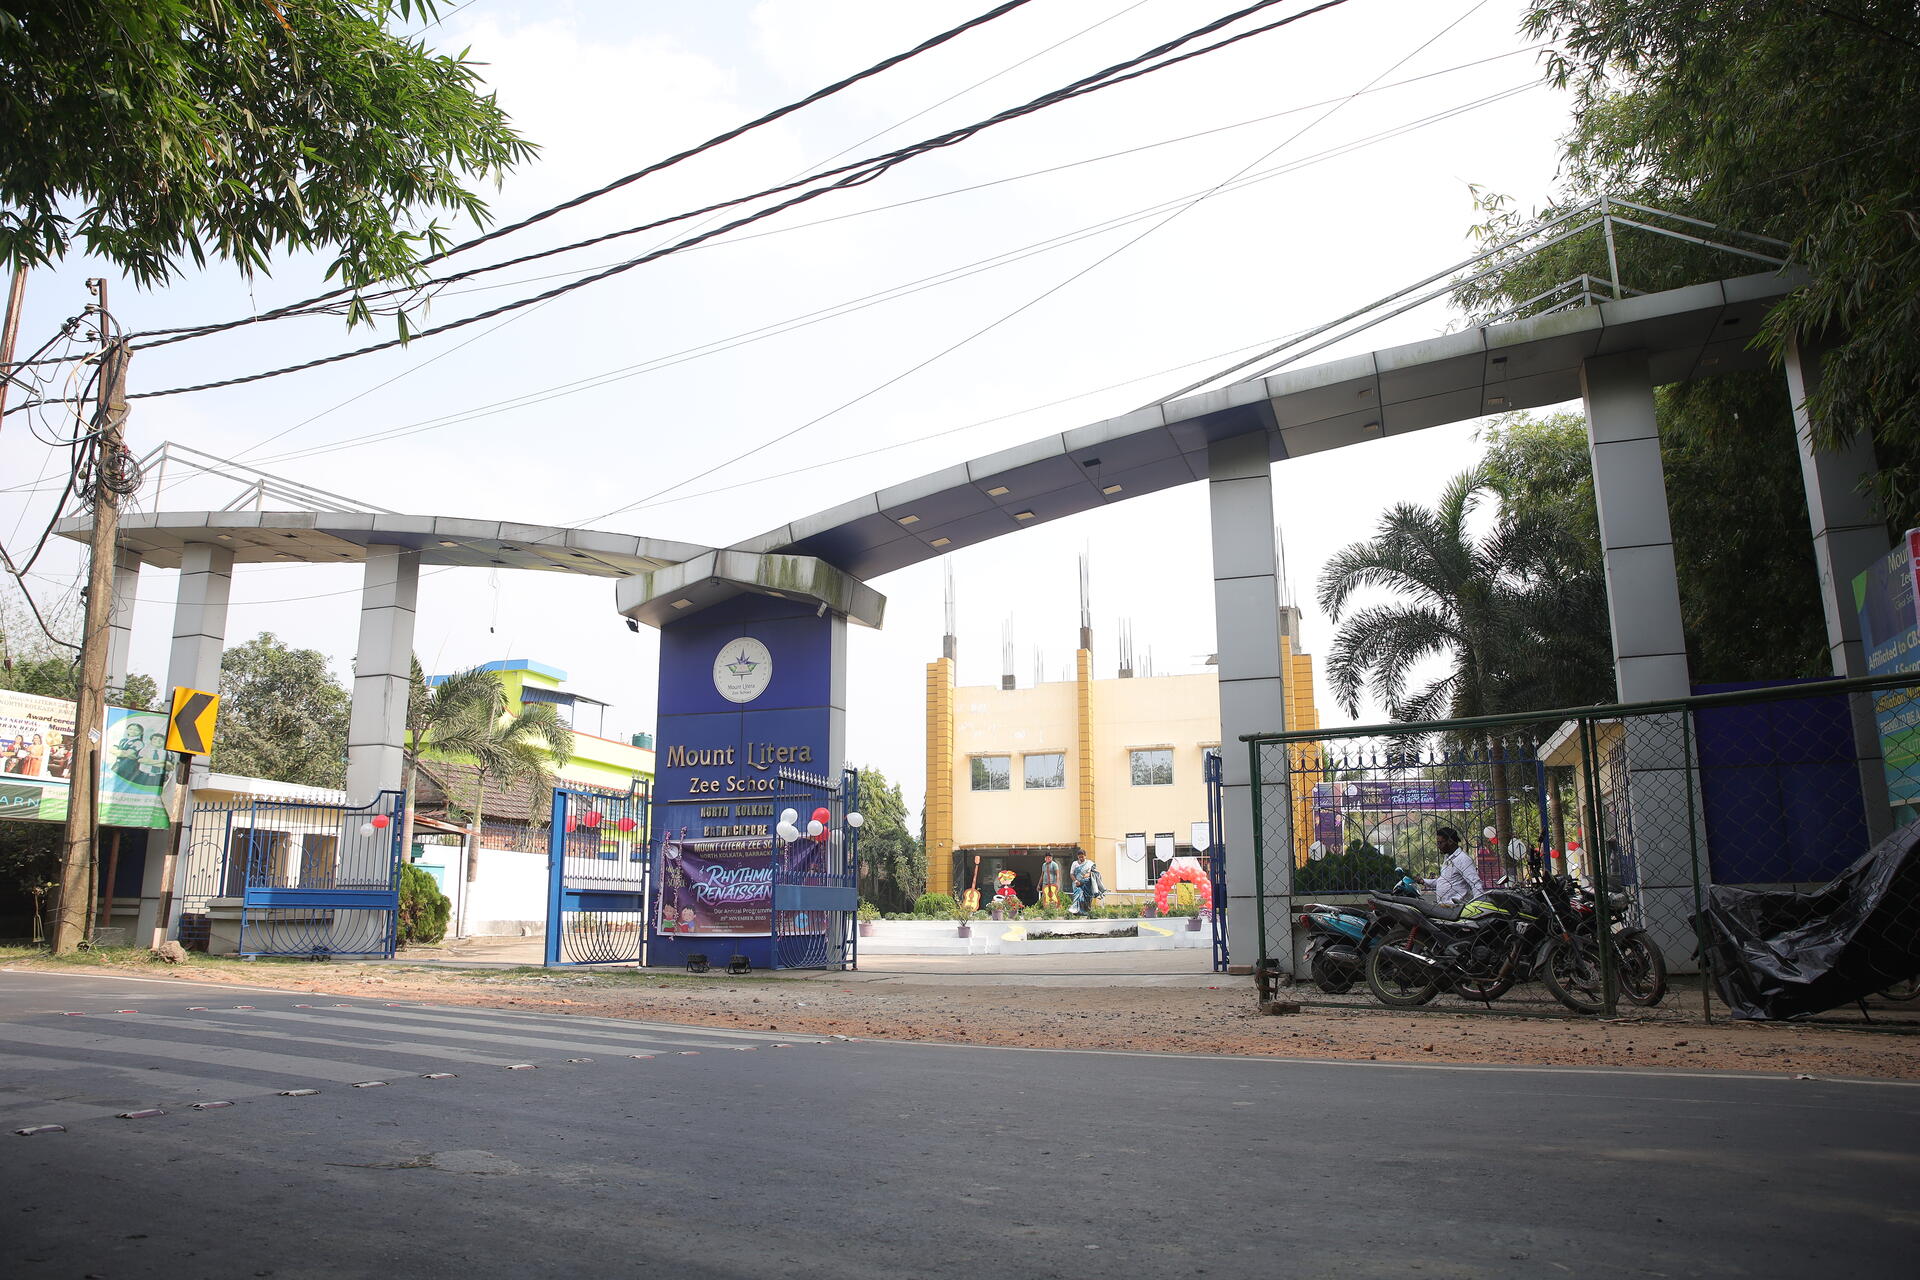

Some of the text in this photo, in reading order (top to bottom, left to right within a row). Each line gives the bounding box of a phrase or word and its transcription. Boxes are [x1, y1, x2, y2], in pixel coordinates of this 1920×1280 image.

[26, 713, 53, 722] Award
[666, 742, 813, 771] Mount Litera
[689, 777, 720, 793] Zee
[700, 804, 774, 817] NORTH KOLKATA
[703, 824, 768, 837] BARRACKPORE
[694, 842, 719, 853] MOUNT
[720, 841, 746, 852] LITERA
[747, 840, 761, 850] ZEE
